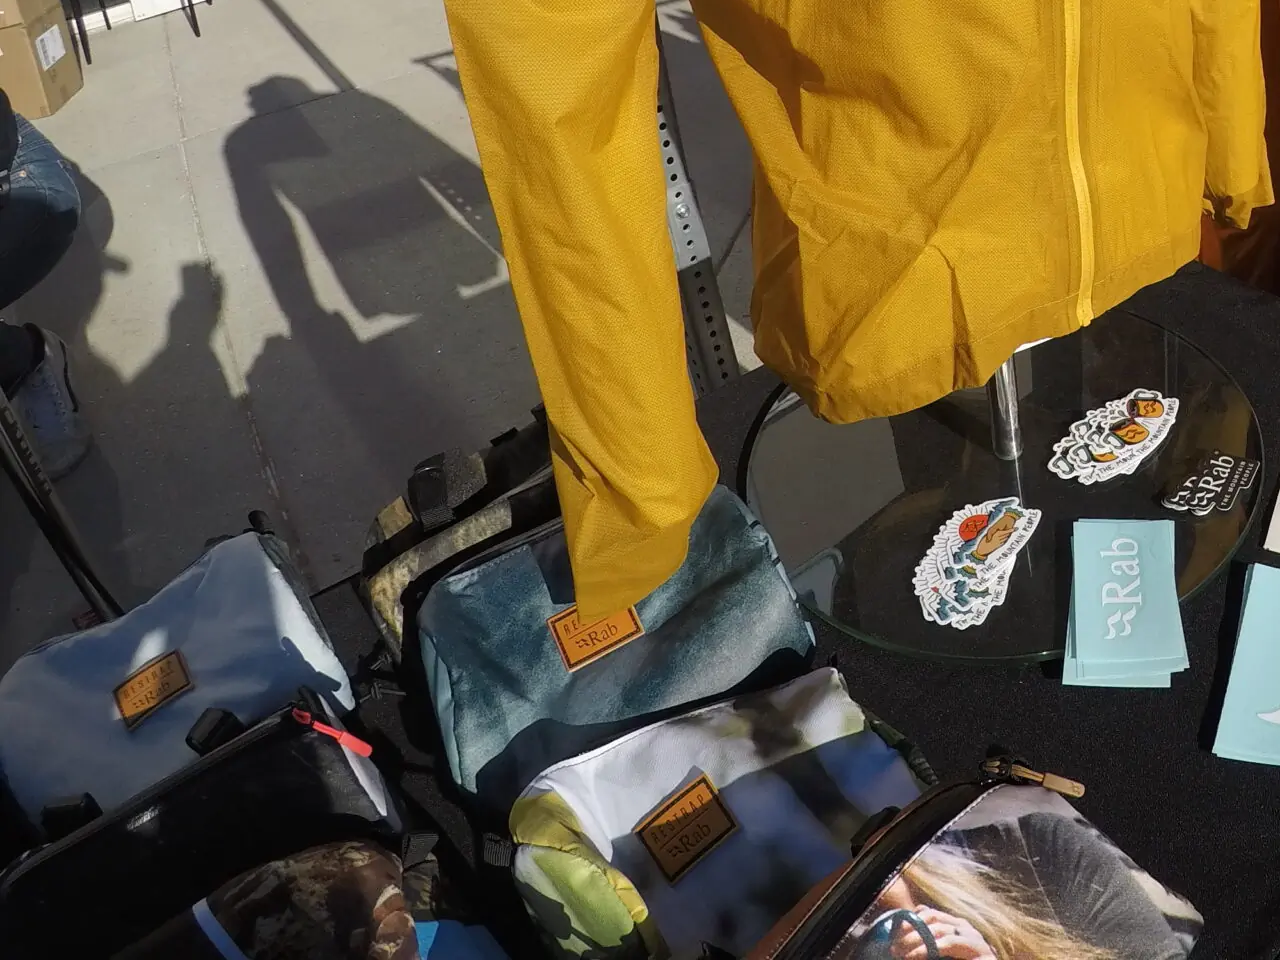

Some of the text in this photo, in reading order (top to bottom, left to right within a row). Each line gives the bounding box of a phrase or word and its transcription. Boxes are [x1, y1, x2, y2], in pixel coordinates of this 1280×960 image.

[1198, 456, 1235, 493] Rab
[1220, 461, 1246, 506] THE MOUNTAIN
[1240, 463, 1254, 485] PEOPLE
[981, 562, 997, 575] THE
[997, 534, 1026, 562] MOUNTAIN
[1023, 511, 1038, 533] PEOPLE
[1100, 538, 1142, 608] Rab
[991, 589, 1003, 603] THE
[971, 609, 985, 622] THE
[587, 623, 618, 647] Rab
[144, 682, 170, 704] Rab
[650, 793, 704, 845] RESTRAP
[679, 824, 711, 853] Rab
